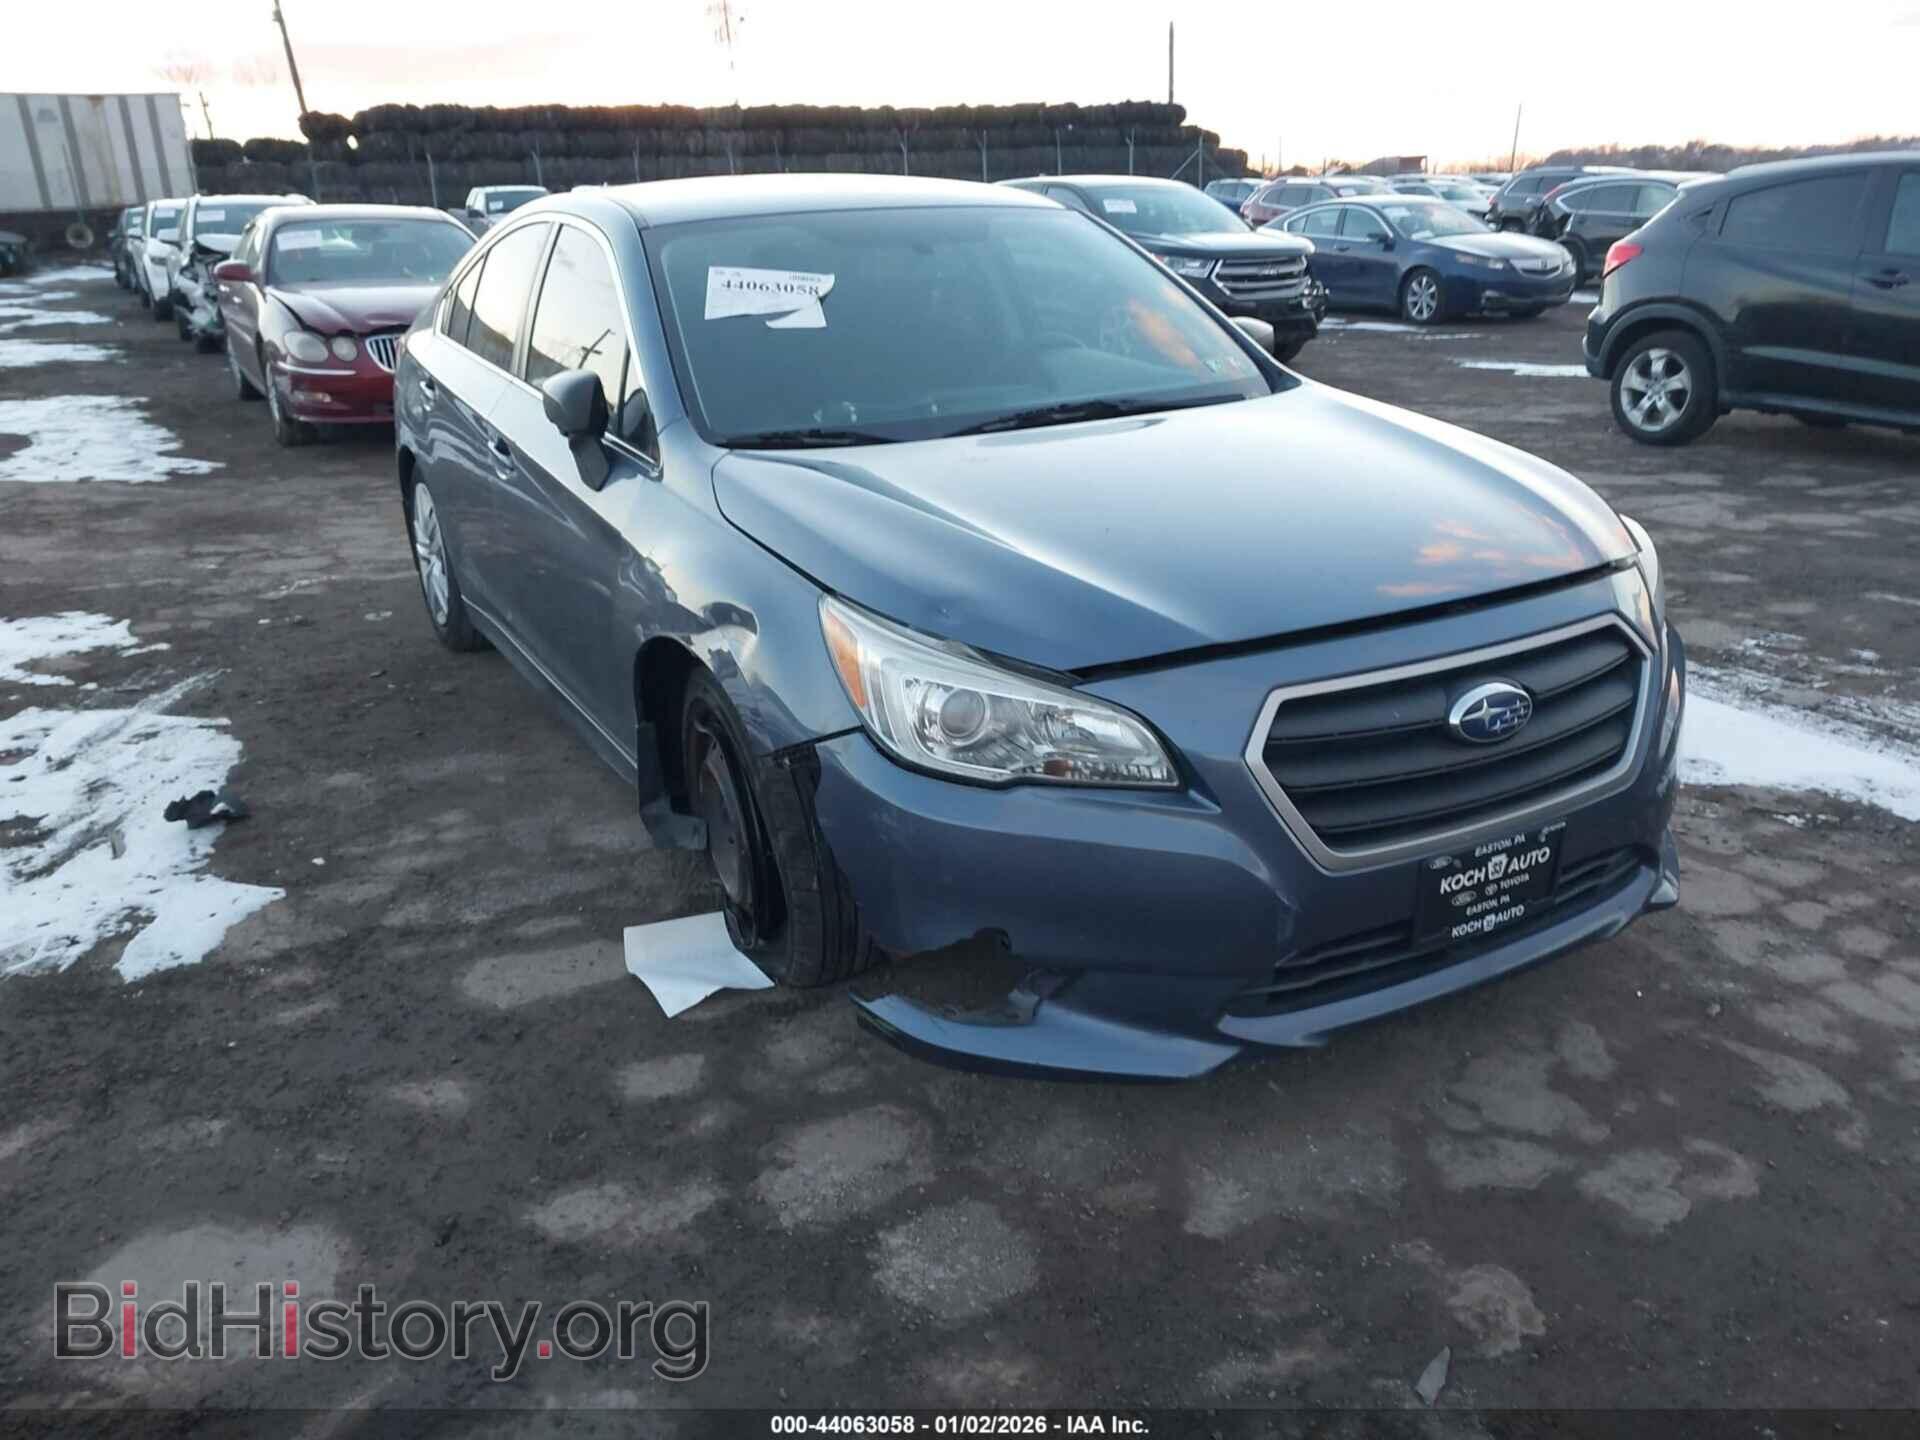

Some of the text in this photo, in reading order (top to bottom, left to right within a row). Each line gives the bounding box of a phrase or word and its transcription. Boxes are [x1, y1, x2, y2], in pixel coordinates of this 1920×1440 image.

[721, 279, 820, 296] 44063058
[1475, 838, 1513, 857] EASTON
[1440, 866, 1486, 895] KOCH
[1508, 846, 1551, 874] AUTO
[1500, 871, 1530, 889] TOYOTA
[1451, 920, 1482, 938] KOCH
[1495, 904, 1525, 923] AUTO
